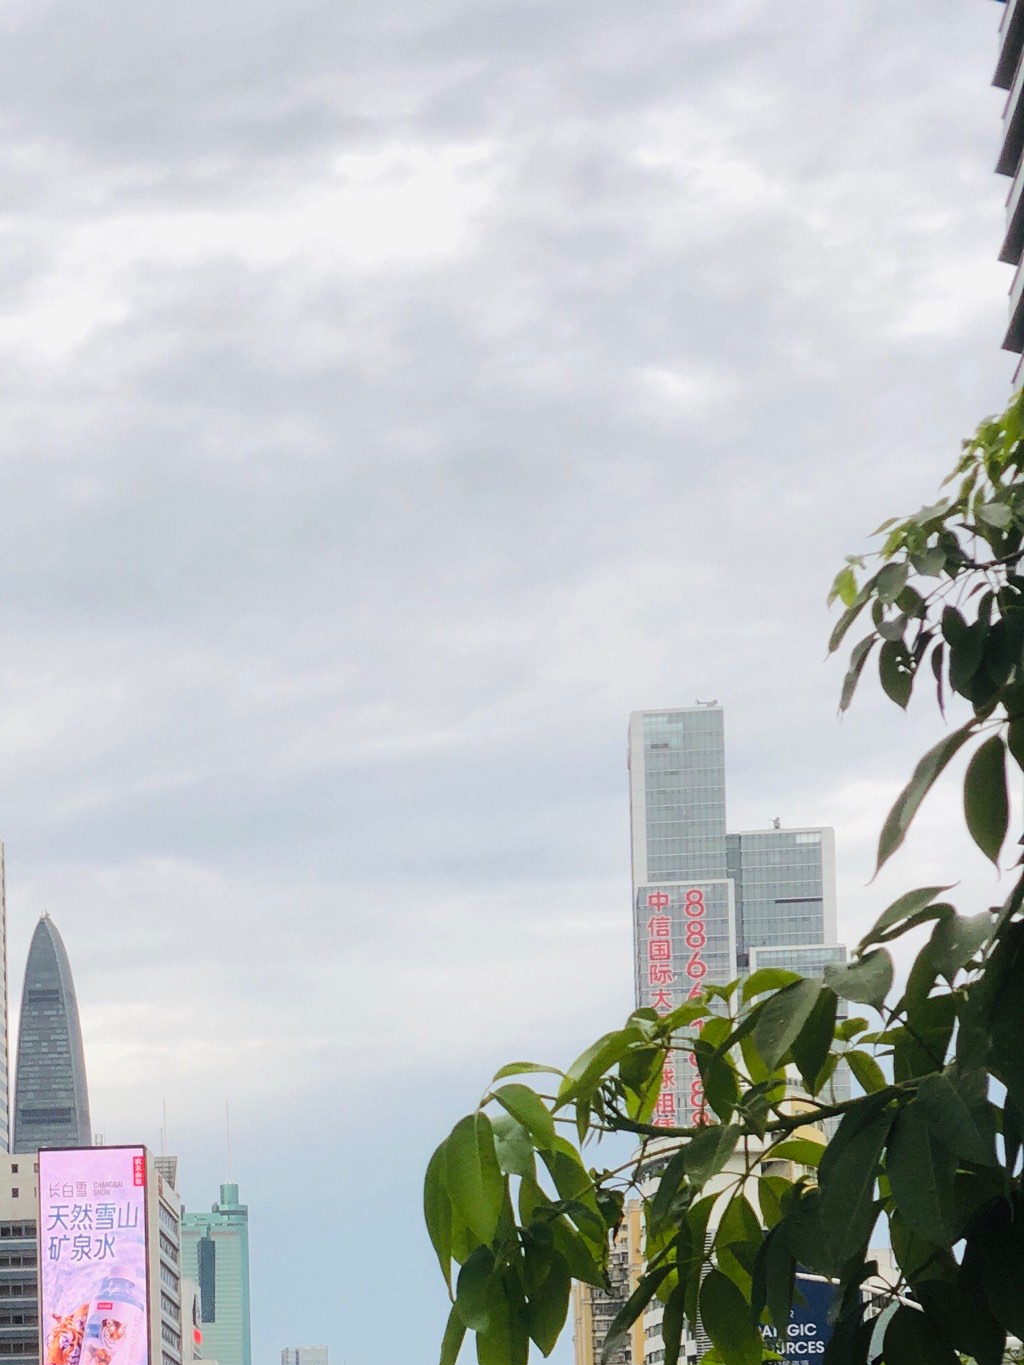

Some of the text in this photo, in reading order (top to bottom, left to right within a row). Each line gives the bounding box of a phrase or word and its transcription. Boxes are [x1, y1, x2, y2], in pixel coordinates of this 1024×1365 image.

[648, 891, 673, 1015] 中信国际大
[48, 1181, 88, 1198] 长白雪
[47, 1202, 138, 1231] 天然雪山
[48, 1232, 115, 1261] 矿泉水
